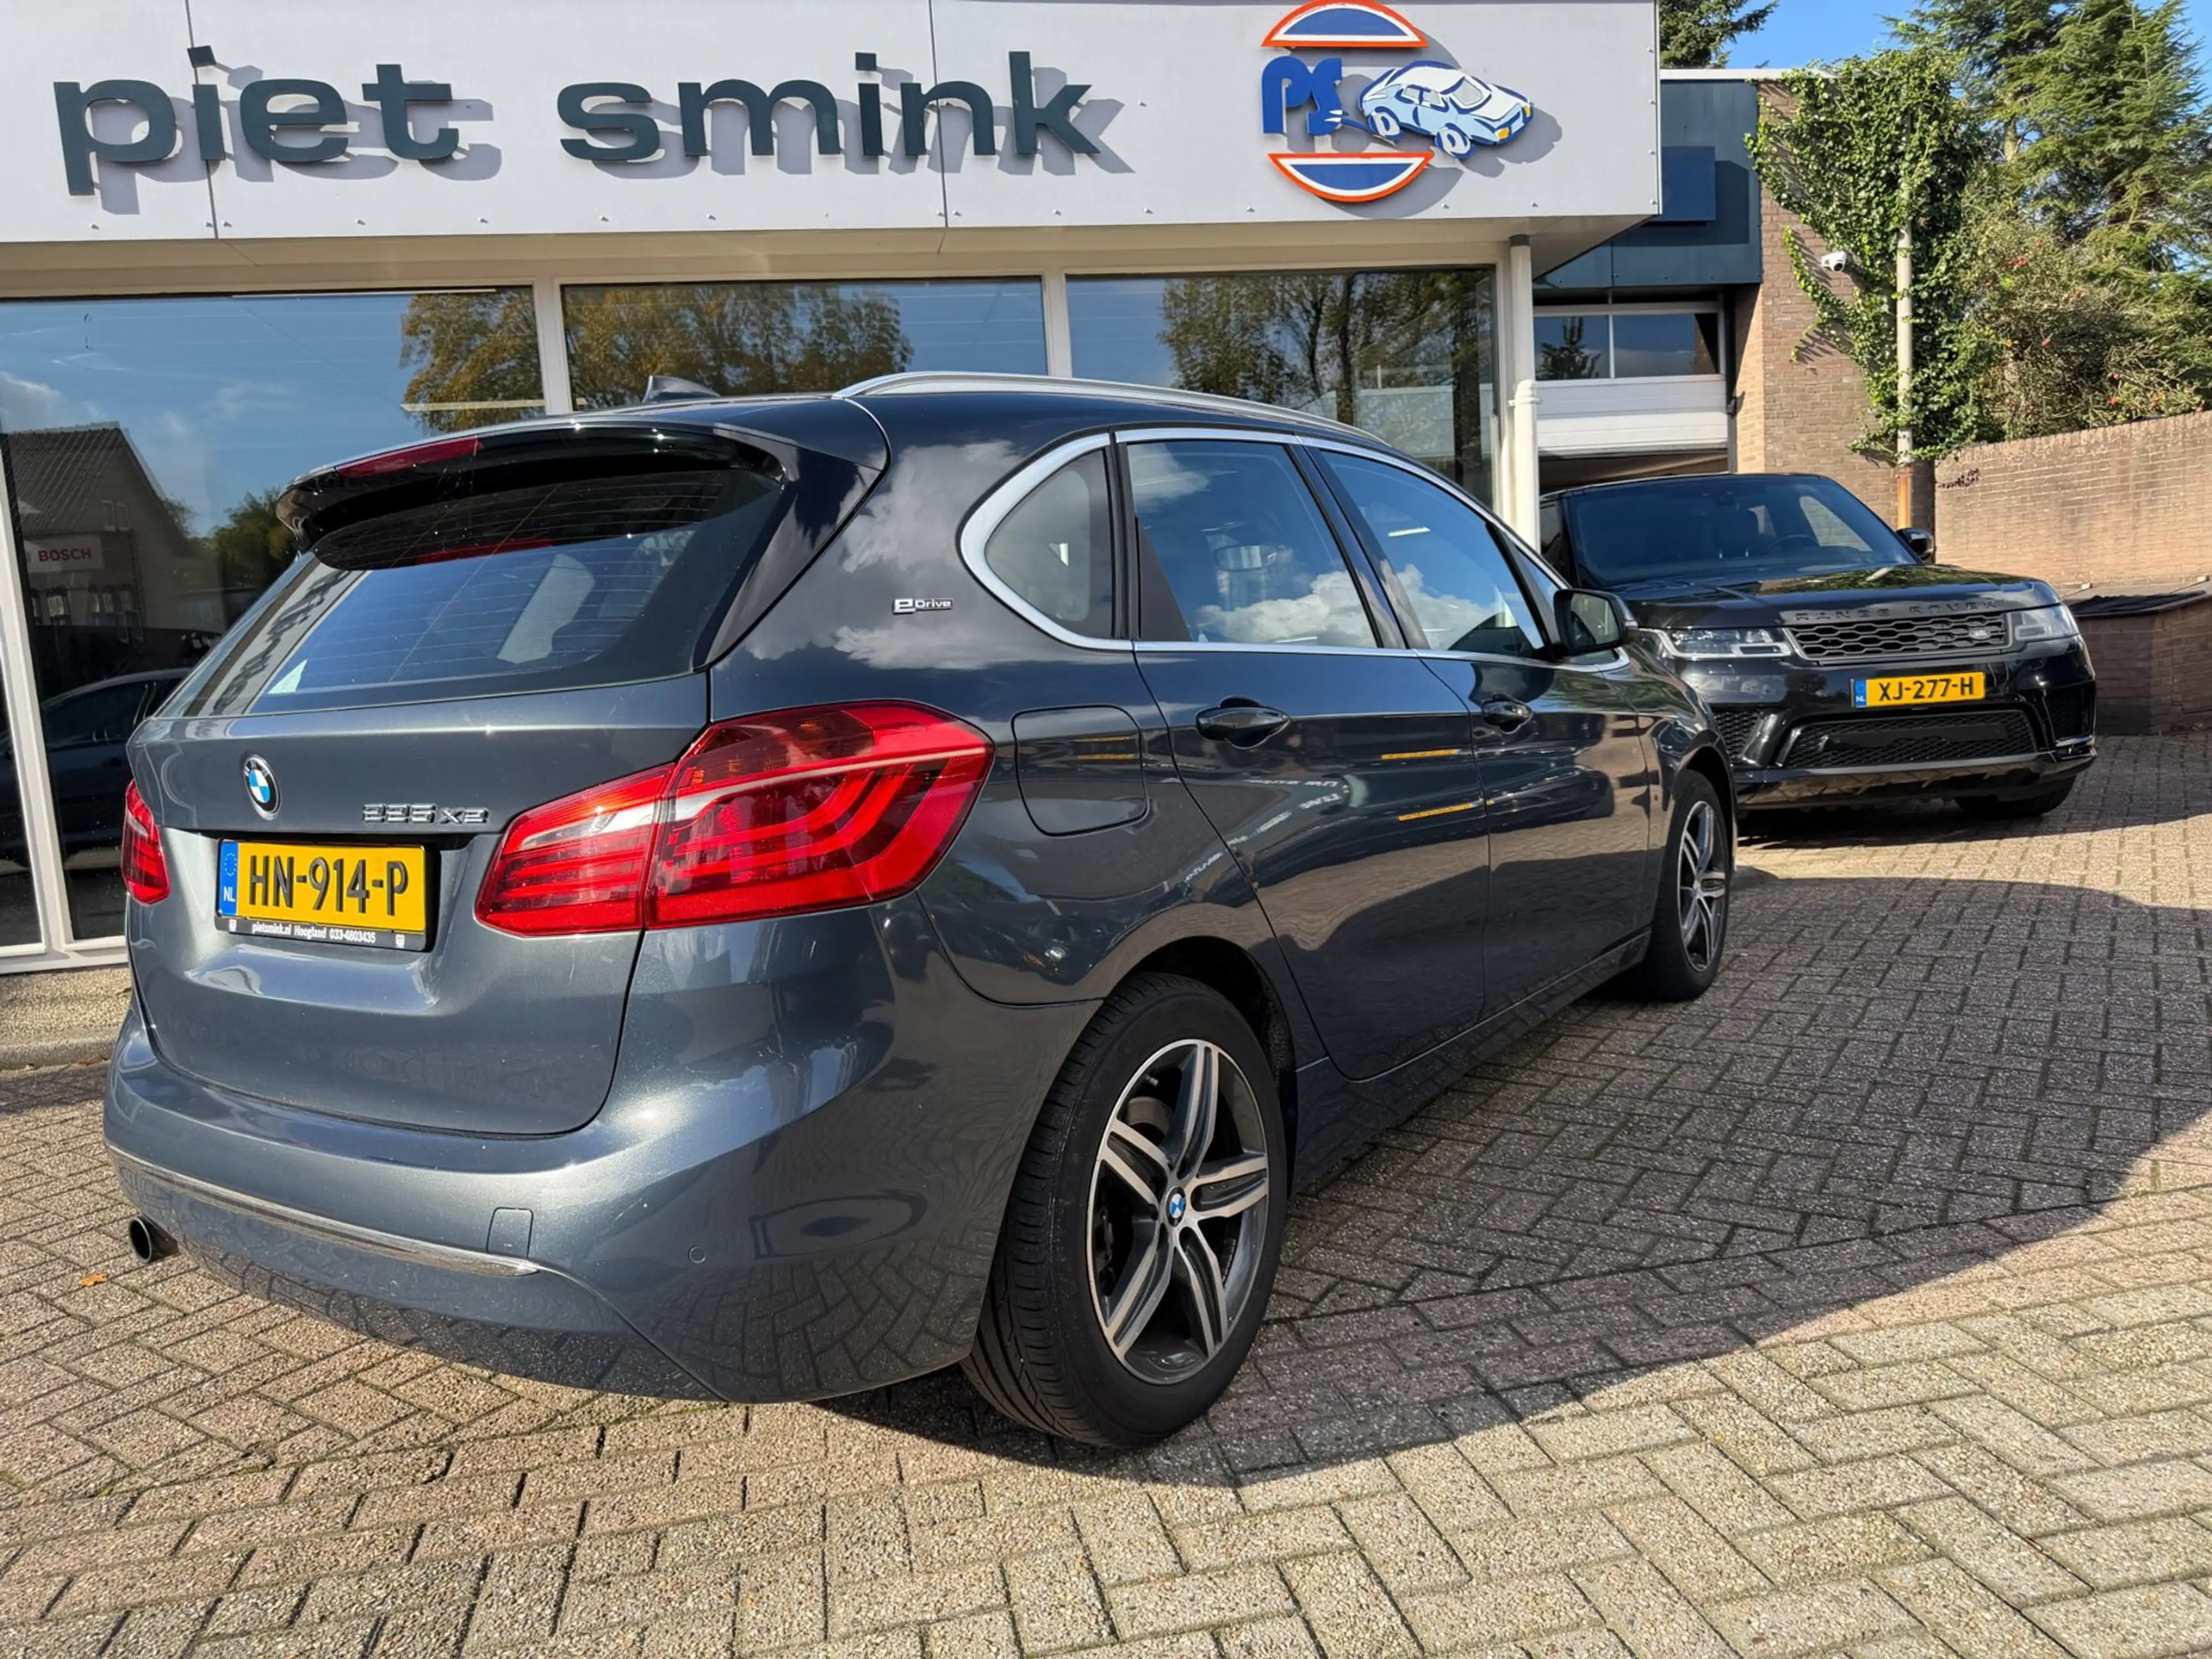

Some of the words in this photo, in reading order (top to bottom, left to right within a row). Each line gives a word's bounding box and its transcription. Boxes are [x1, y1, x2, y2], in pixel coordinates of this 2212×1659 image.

[53, 45, 459, 196] piet
[557, 51, 1101, 162] smink
[38, 548, 92, 562] BOSCH
[1796, 608, 1890, 620] RANGE
[1909, 600, 1996, 614] ROVER
[1878, 676, 1973, 701] XJ-277-H
[223, 886, 236, 903] NL
[249, 855, 409, 916] HN-914-P
[252, 922, 291, 935] pietsmink.nl
[294, 925, 326, 940] Hoogland
[329, 928, 376, 944] 033-4803435
